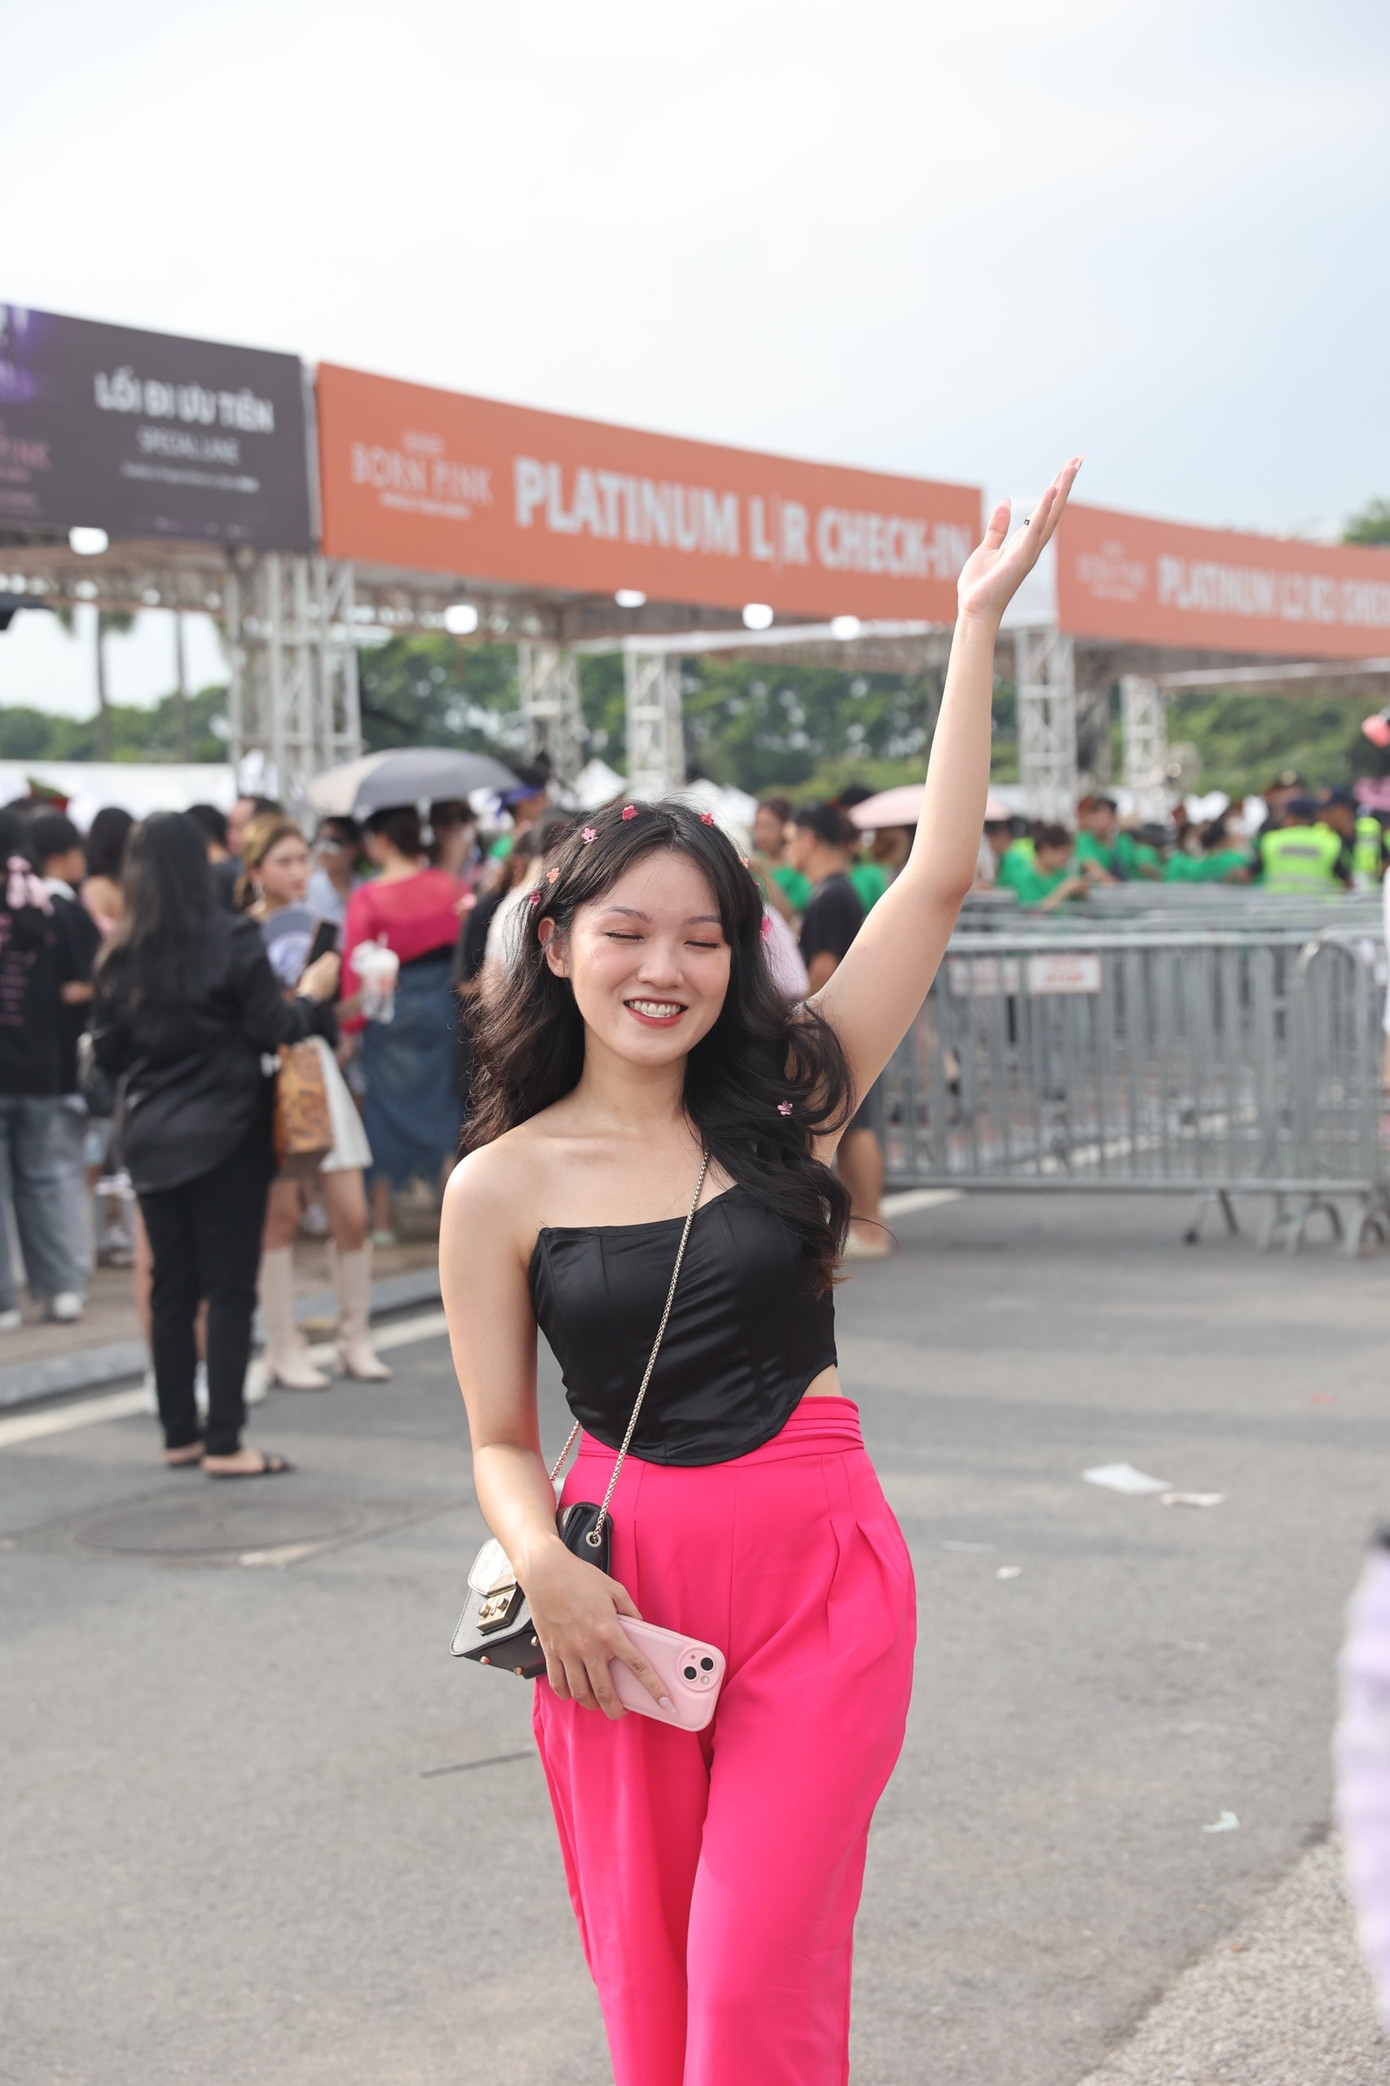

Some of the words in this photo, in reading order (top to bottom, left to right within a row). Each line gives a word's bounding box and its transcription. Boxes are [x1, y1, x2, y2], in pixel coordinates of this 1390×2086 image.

[350, 440, 427, 492] BORN
[431, 457, 494, 507] PINK
[515, 455, 738, 557] PLATINUM
[815, 503, 973, 582] CHECK-IN
